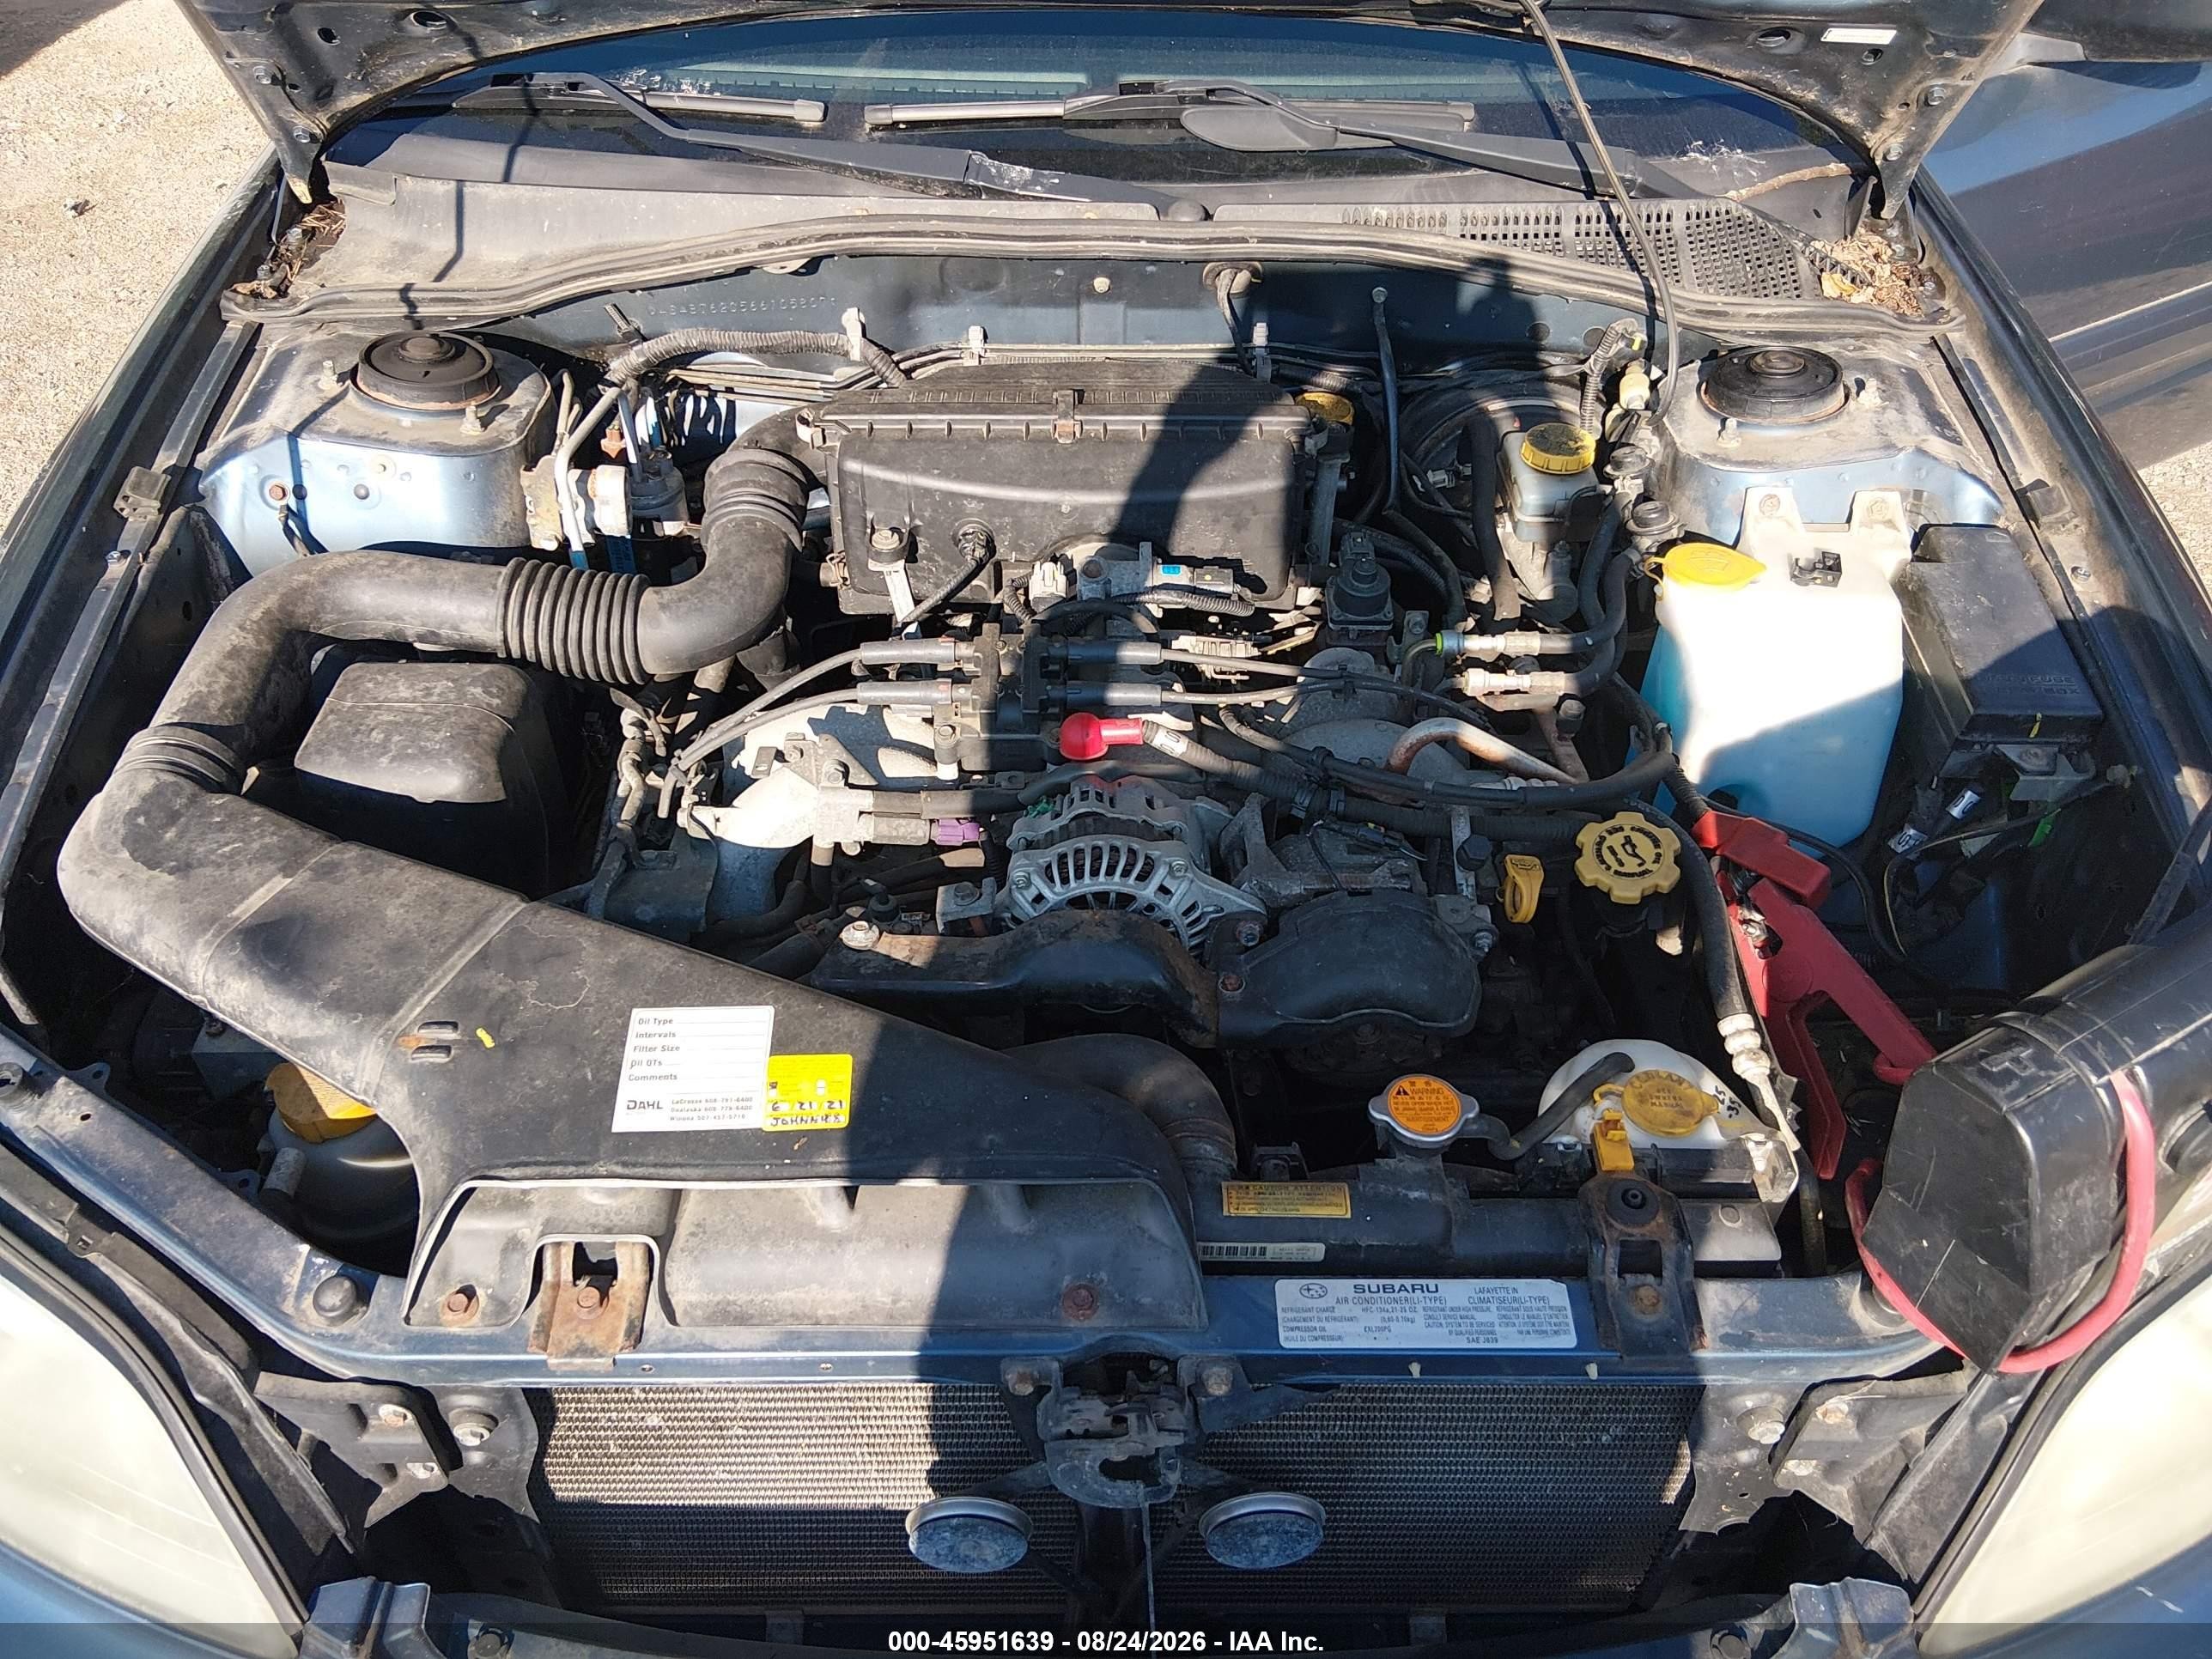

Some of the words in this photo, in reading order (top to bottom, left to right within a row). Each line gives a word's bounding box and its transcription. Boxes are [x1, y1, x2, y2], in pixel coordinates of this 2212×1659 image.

[653, 1018, 673, 1026] Type
[660, 1044, 680, 1053] Size
[630, 1059, 643, 1067] Oil
[626, 1099, 663, 1110] DAHL
[1353, 1283, 1439, 1294] SUBARU
[1474, 1286, 1510, 1295] LAFAYETTE
[1335, 1296, 1350, 1305] AIR
